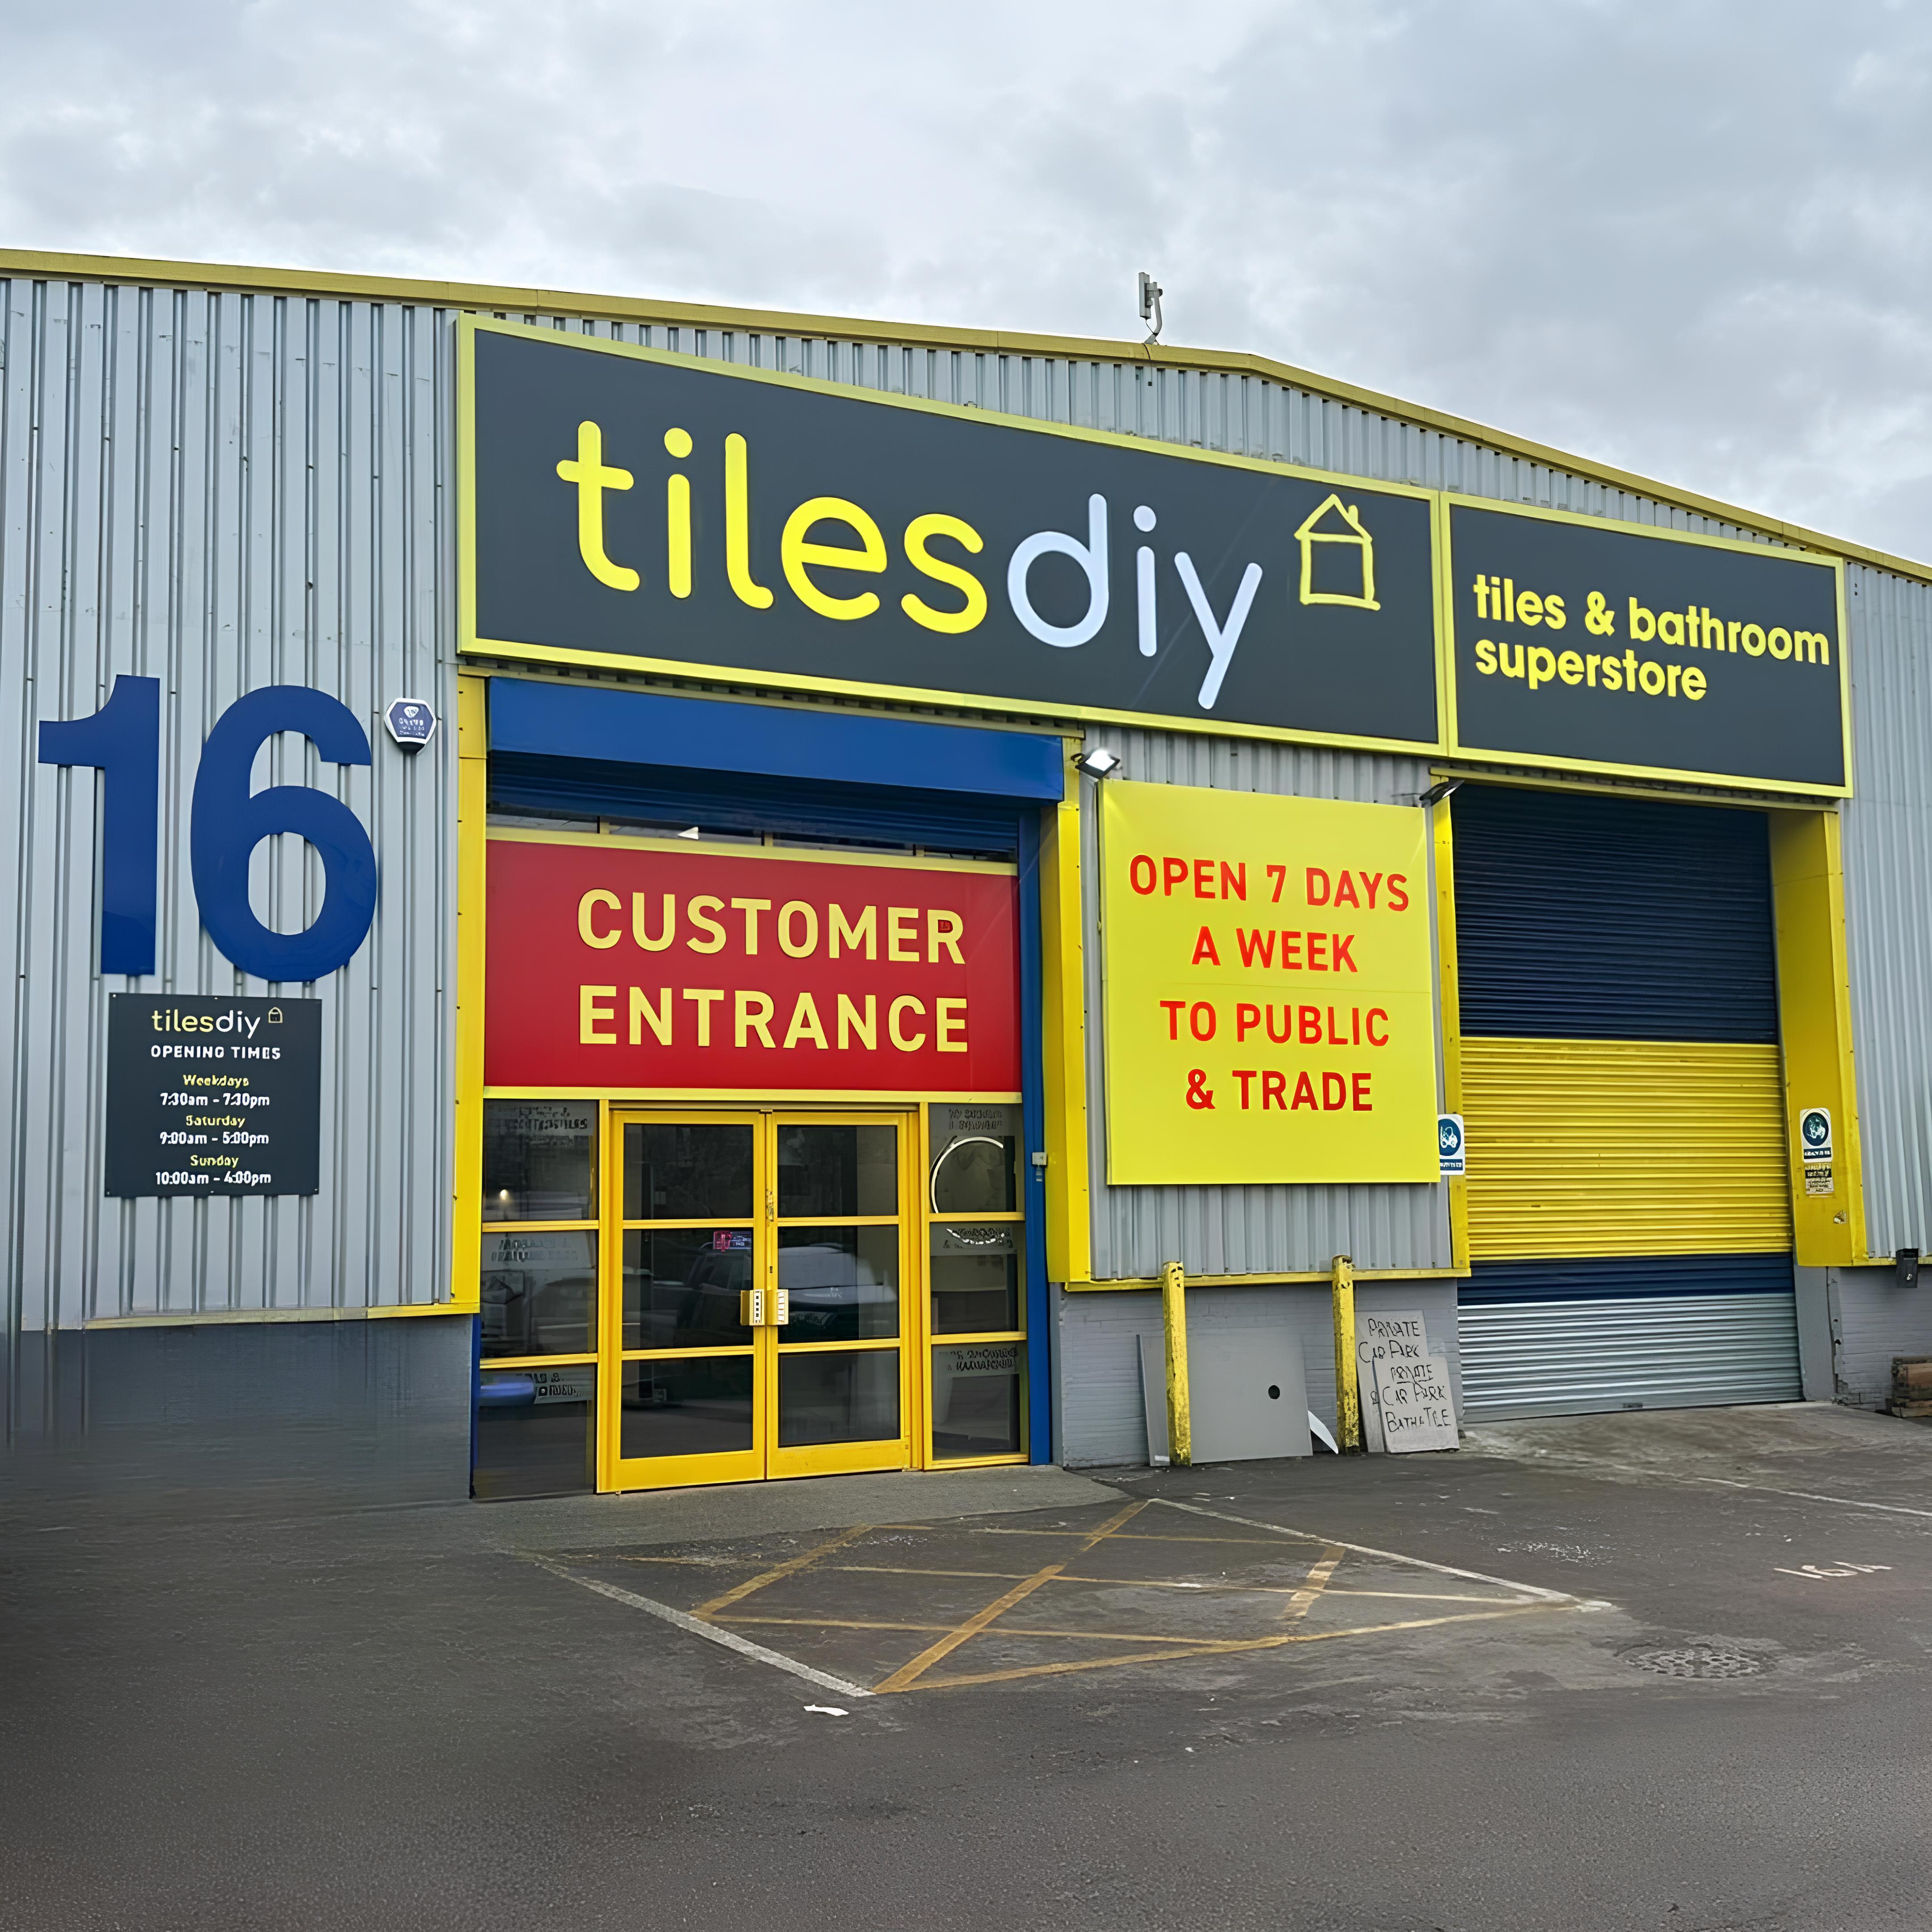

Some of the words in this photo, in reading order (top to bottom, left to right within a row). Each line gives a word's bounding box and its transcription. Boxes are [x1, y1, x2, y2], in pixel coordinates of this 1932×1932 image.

[556, 420, 1263, 710] tilesdiy
[1474, 575, 1566, 629] tiles
[1585, 591, 1614, 636] &
[1629, 597, 1830, 665] bathroom
[1475, 640, 1707, 700] superstore
[38, 676, 377, 981] 16
[1131, 855, 1246, 900] OPEN
[1267, 865, 1286, 902] 7
[1307, 868, 1408, 911] DAYS
[578, 890, 965, 964] CUSTOMER
[1192, 927, 1220, 965] A
[1236, 928, 1357, 972] WEEK
[152, 1009, 260, 1039] tilesdiy
[580, 985, 967, 1052] ENTRANCE
[1160, 1001, 1216, 1041] TO
[1237, 1004, 1388, 1046] PUBLIC
[151, 1045, 224, 1058] OPENING
[231, 1046, 280, 1059] TIMES
[160, 1093, 208, 1106] 7:30am
[223, 1093, 269, 1109] 7:30pm
[183, 1075, 249, 1089] Weekdays
[1186, 1069, 1215, 1109] &
[1233, 1071, 1372, 1111] TRADE
[160, 1132, 207, 1144] 9:00am
[223, 1131, 269, 1147] 5:00pm
[186, 1115, 245, 1128] Saturday
[156, 1172, 208, 1185] 10:00am
[191, 1155, 239, 1168] Sunday
